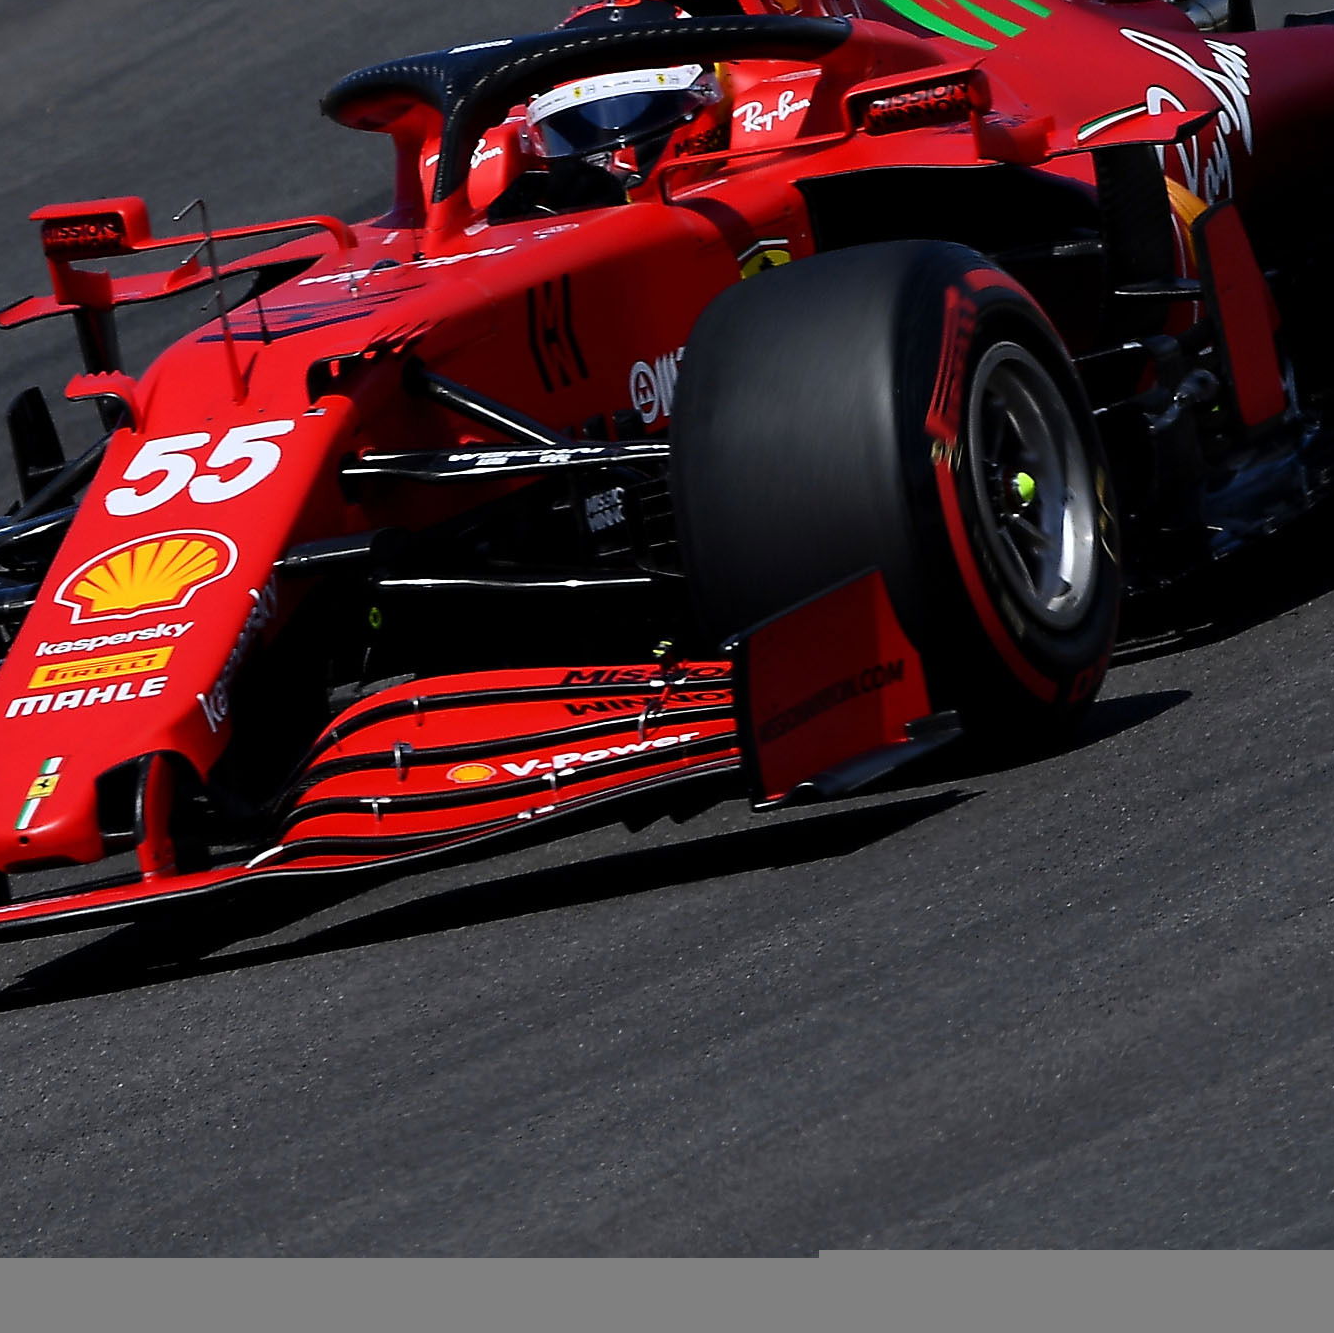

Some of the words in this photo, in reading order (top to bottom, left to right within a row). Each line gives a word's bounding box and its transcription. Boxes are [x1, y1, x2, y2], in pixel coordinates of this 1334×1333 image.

[732, 90, 811, 133] Ray-Ban
[104, 419, 296, 517] 55
[35, 622, 194, 657] kaspersky
[43, 652, 161, 684] PIRELLI
[5, 676, 168, 719] MAHLE
[503, 732, 699, 778] V-Power
